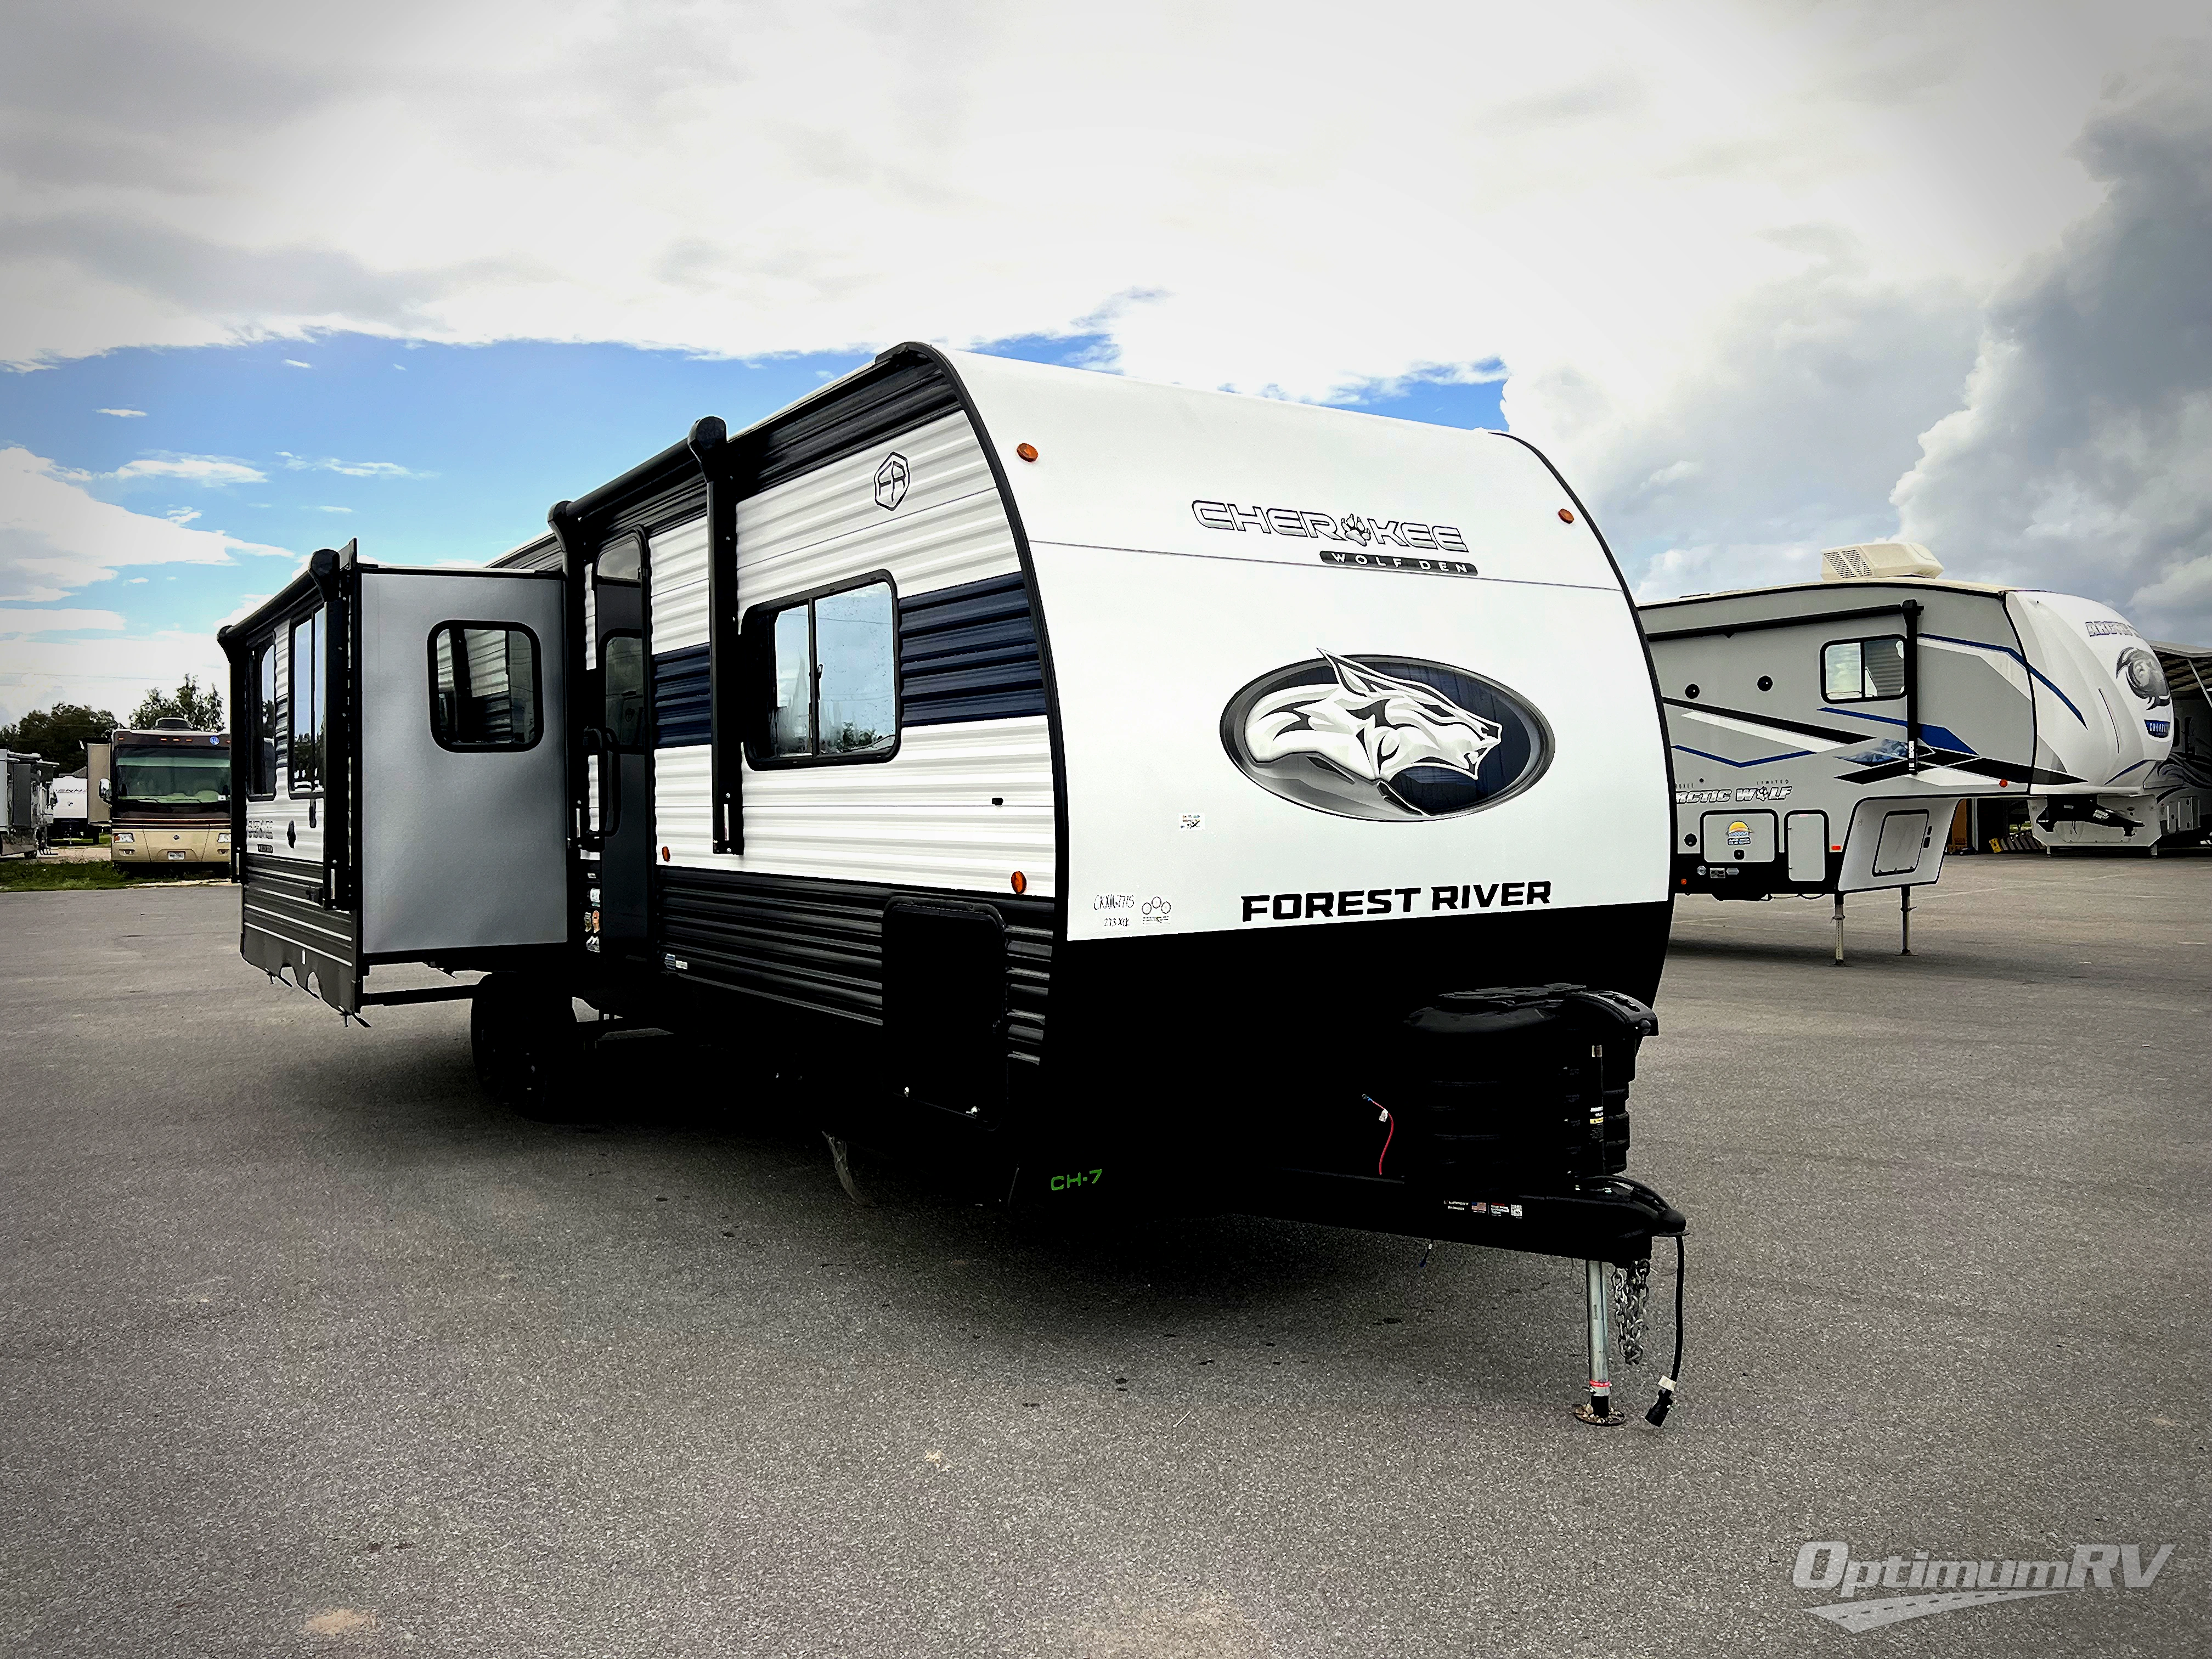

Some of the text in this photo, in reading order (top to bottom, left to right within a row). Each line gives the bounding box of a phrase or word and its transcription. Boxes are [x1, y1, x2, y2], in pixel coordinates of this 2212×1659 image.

[1191, 500, 1469, 552] CHEROKEE
[1331, 552, 1469, 573] WOLF DEN
[1676, 786, 1793, 804] RCTIC WOLF
[1240, 881, 1551, 922] FOREST RIVER
[1051, 1169, 1102, 1190] CH-7
